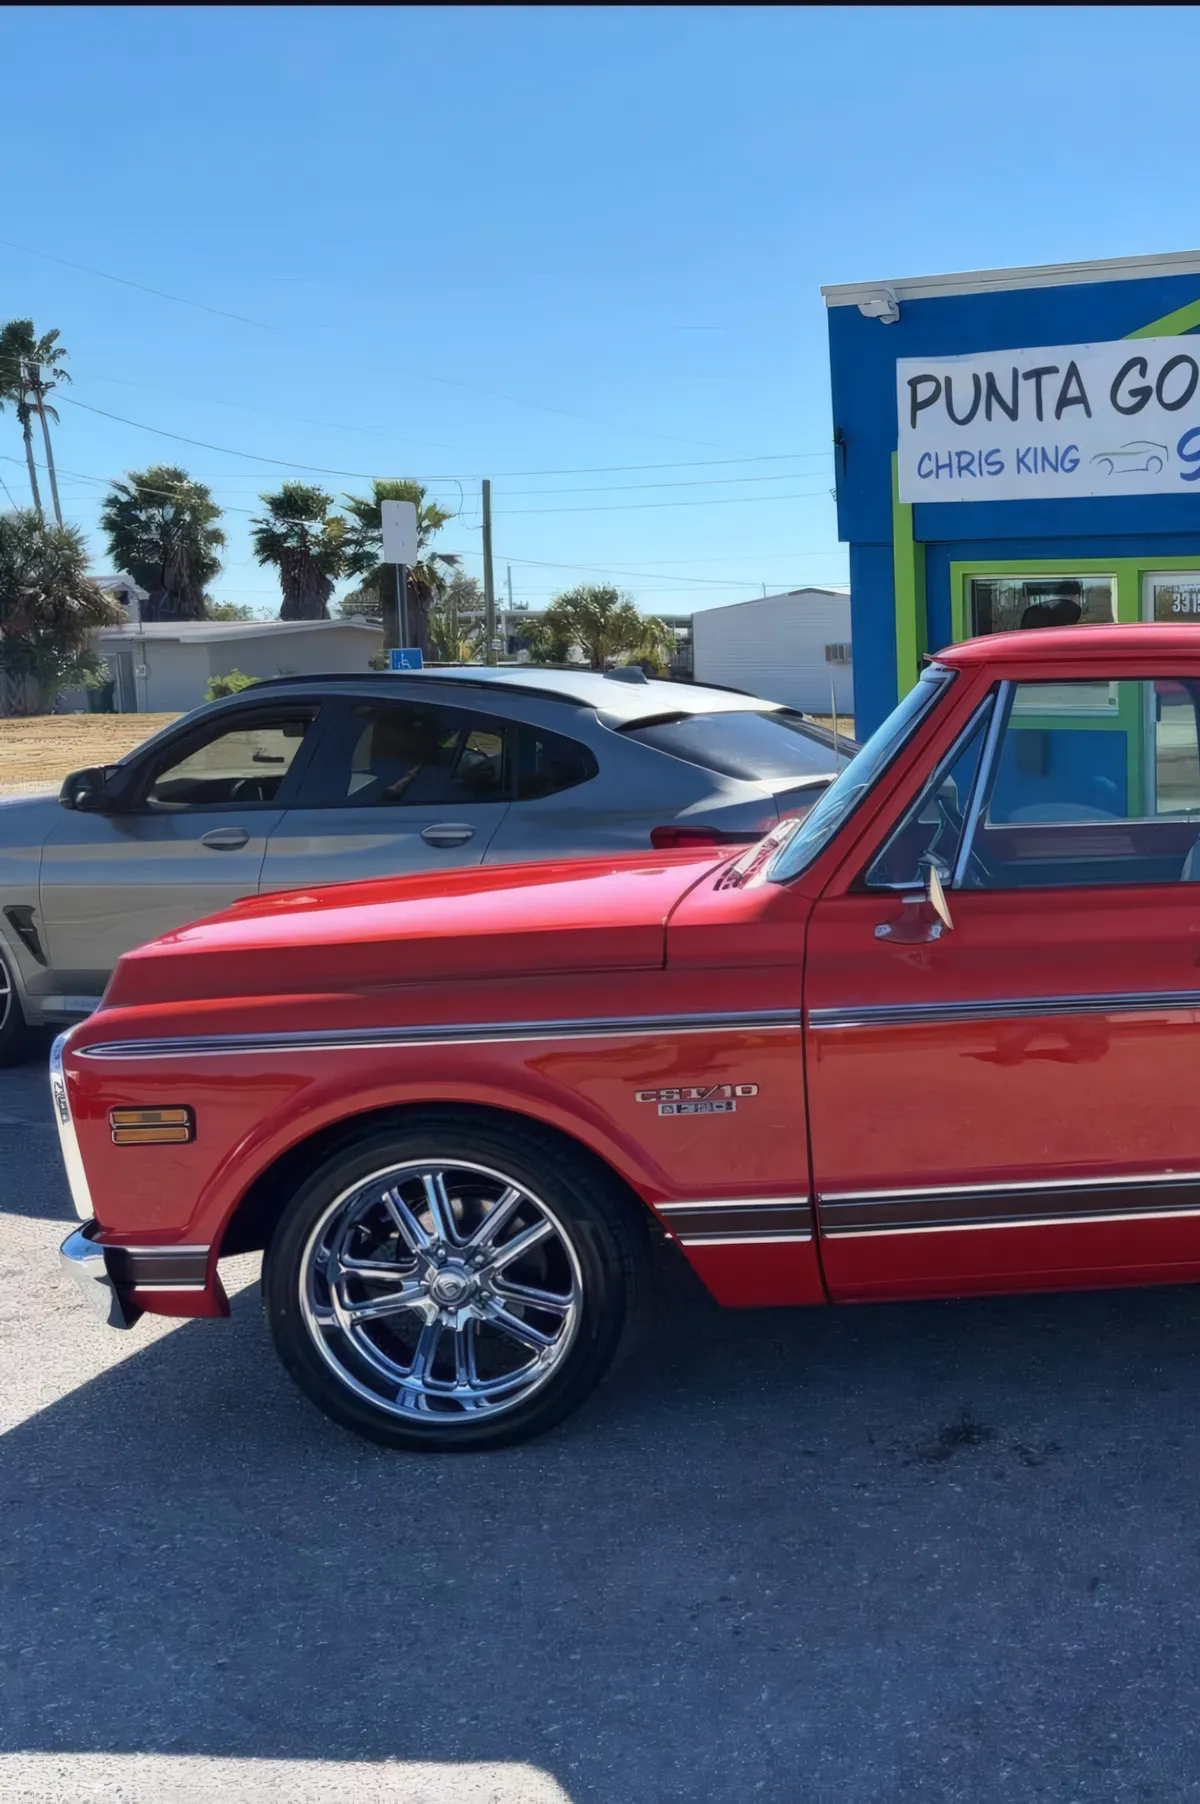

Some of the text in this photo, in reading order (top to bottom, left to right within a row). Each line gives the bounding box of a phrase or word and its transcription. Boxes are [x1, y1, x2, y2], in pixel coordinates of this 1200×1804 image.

[906, 360, 1093, 429] PUNTA
[916, 447, 1005, 480] CHRIS
[1016, 444, 1081, 475] KING
